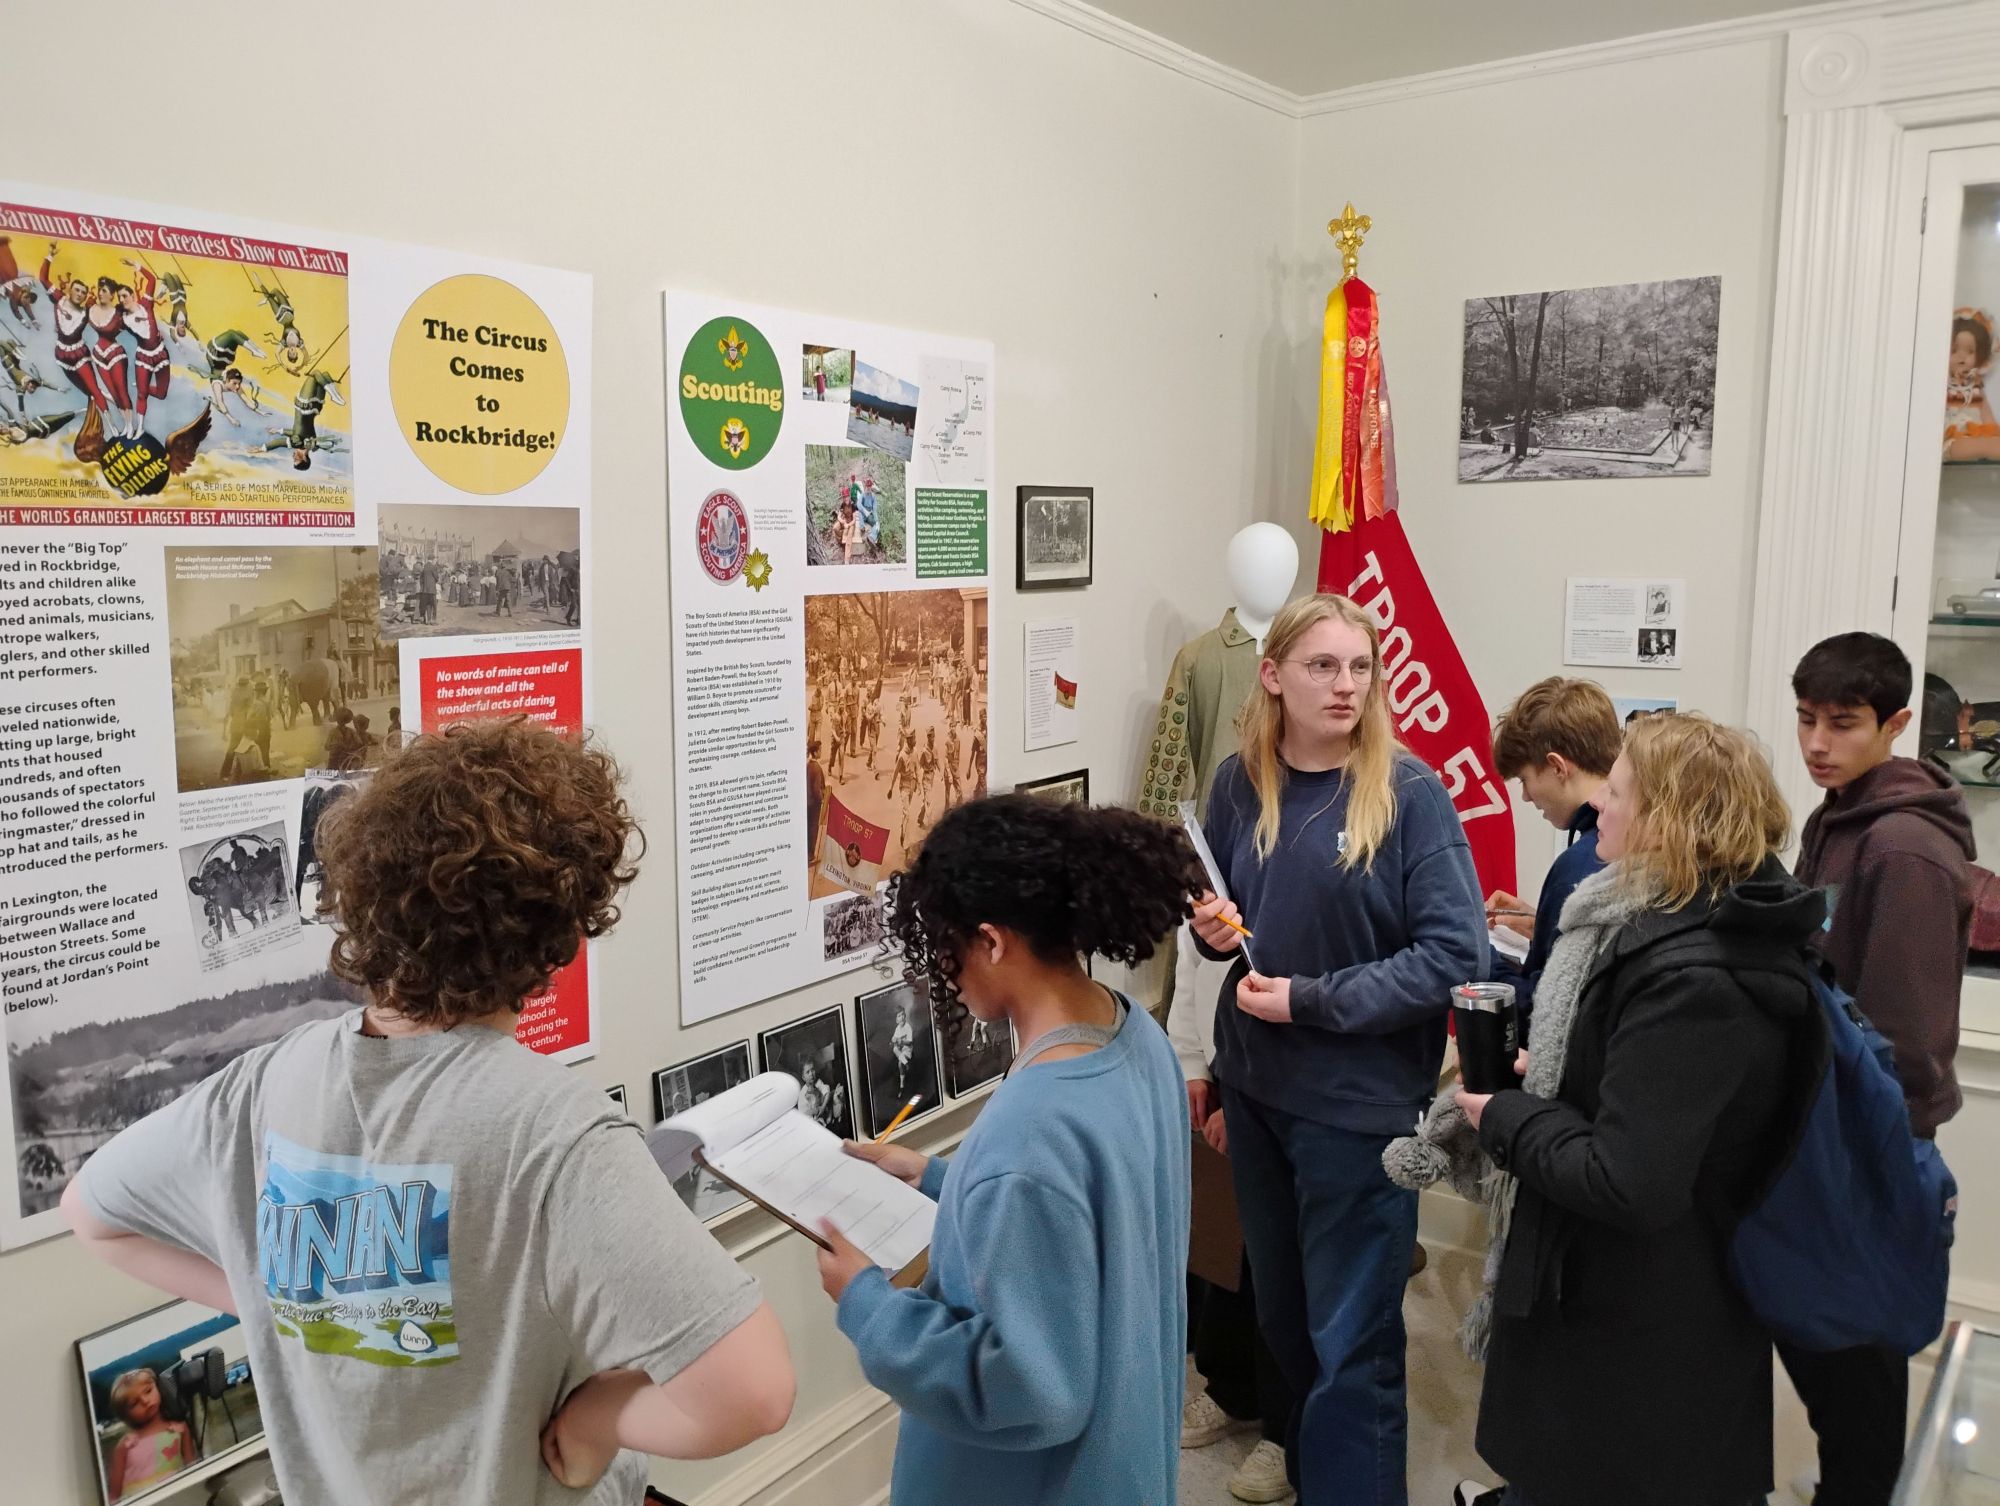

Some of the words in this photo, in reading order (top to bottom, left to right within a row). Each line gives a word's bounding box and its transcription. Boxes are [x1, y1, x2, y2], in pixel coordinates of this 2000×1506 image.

[78, 216, 97, 239] &
[91, 216, 154, 249] Bailey
[157, 226, 232, 258] Greatest
[230, 237, 275, 264] Show
[278, 251, 301, 267] on
[298, 247, 347, 274] Earth
[422, 318, 468, 343] The
[475, 325, 548, 353] Circus
[449, 356, 524, 383] Comes
[682, 374, 782, 412] Scouting
[475, 394, 500, 413] to
[415, 421, 555, 453] Rockbridge!
[103, 441, 124, 464] THE
[103, 443, 151, 487] FLYING
[9, 478, 57, 488] APPEARANCE
[60, 479, 68, 487] IN
[70, 478, 99, 488] AMERICA
[121, 457, 168, 498] DILLONS
[183, 482, 191, 491] IN
[194, 482, 202, 491] A
[203, 481, 233, 491] SERIES
[235, 483, 245, 492] OF
[248, 482, 270, 492] MOST
[272, 483, 317, 494] MARVELOUS
[11, 487, 37, 498] FAMOUS
[37, 488, 78, 499] CONTINENTAL
[78, 489, 110, 499] FAVORITES
[190, 491, 217, 501] FEATS
[219, 493, 237, 502] AND
[239, 493, 281, 503] STARTLING
[282, 493, 345, 504] PERFORMANCES
[703, 496, 721, 519] EAGLE
[723, 495, 742, 517] SCOUT
[0, 510, 16, 524] HE
[20, 509, 70, 524] WORLD'S
[219, 512, 285, 526] AMUSEMENT
[43, 542, 65, 553] the
[68, 542, 95, 555] "Big
[98, 542, 127, 555] Top"
[24, 560, 36, 571] in
[41, 559, 119, 573] Rockbridge,
[700, 542, 726, 579] SCOUTING
[729, 542, 747, 577] AMERICA
[19, 578, 44, 589] and
[48, 577, 102, 588] children
[106, 576, 136, 587] alike
[33, 595, 93, 606] acrobats,
[98, 593, 144, 604] clowns,
[29, 612, 84, 624] animals,
[88, 611, 153, 622] musicians,
[45, 630, 98, 641] walkers,
[41, 647, 66, 659] and
[70, 646, 105, 657] other
[109, 643, 149, 655] skilled
[18, 665, 96, 681] performers.
[436, 671, 451, 682] No
[453, 668, 484, 680] words
[485, 666, 497, 678] of
[497, 666, 522, 677] mine
[523, 666, 540, 675] can
[542, 662, 557, 673] tell
[558, 661, 568, 672] of
[437, 687, 454, 698] the
[455, 685, 483, 697] show
[483, 682, 503, 694] and
[504, 681, 517, 692] all
[518, 680, 534, 691] the
[1348, 551, 1449, 733] TROOP
[1435, 746, 1507, 822] 57
[437, 699, 490, 715] wonderful
[491, 699, 511, 710] acts
[512, 696, 524, 707] of
[524, 695, 555, 706] daring
[528, 709, 557, 724] pened
[843, 814, 864, 834] TROOP
[864, 828, 874, 840] 57
[12, 889, 82, 907] Lexington,
[86, 883, 106, 894] the
[0, 905, 75, 926] fairgrounds
[78, 900, 109, 912] were
[112, 889, 157, 906] located
[0, 927, 56, 944] between
[59, 917, 108, 933] Wallace
[112, 909, 134, 923] and
[0, 944, 56, 962] Houston
[60, 934, 108, 950] Streets.
[112, 927, 145, 940] Some
[1, 965, 40, 982] years,
[44, 959, 65, 970] the
[68, 951, 104, 965] circus
[108, 941, 141, 957] could
[145, 939, 160, 949] be
[2, 978, 42, 996] found
[46, 976, 58, 987] at
[62, 965, 113, 984] Jordan's
[117, 957, 148, 972] Point
[4, 993, 57, 1015] (below).
[530, 992, 557, 1007] largely
[518, 1008, 547, 1025] ldhood
[548, 1007, 556, 1016] in
[527, 1023, 554, 1036] during
[555, 1016, 569, 1027] the
[531, 1033, 564, 1049] century.
[330, 1301, 363, 1324] Ridge
[366, 1304, 376, 1319] to
[379, 1297, 401, 1319] the
[402, 1295, 439, 1320] Bay
